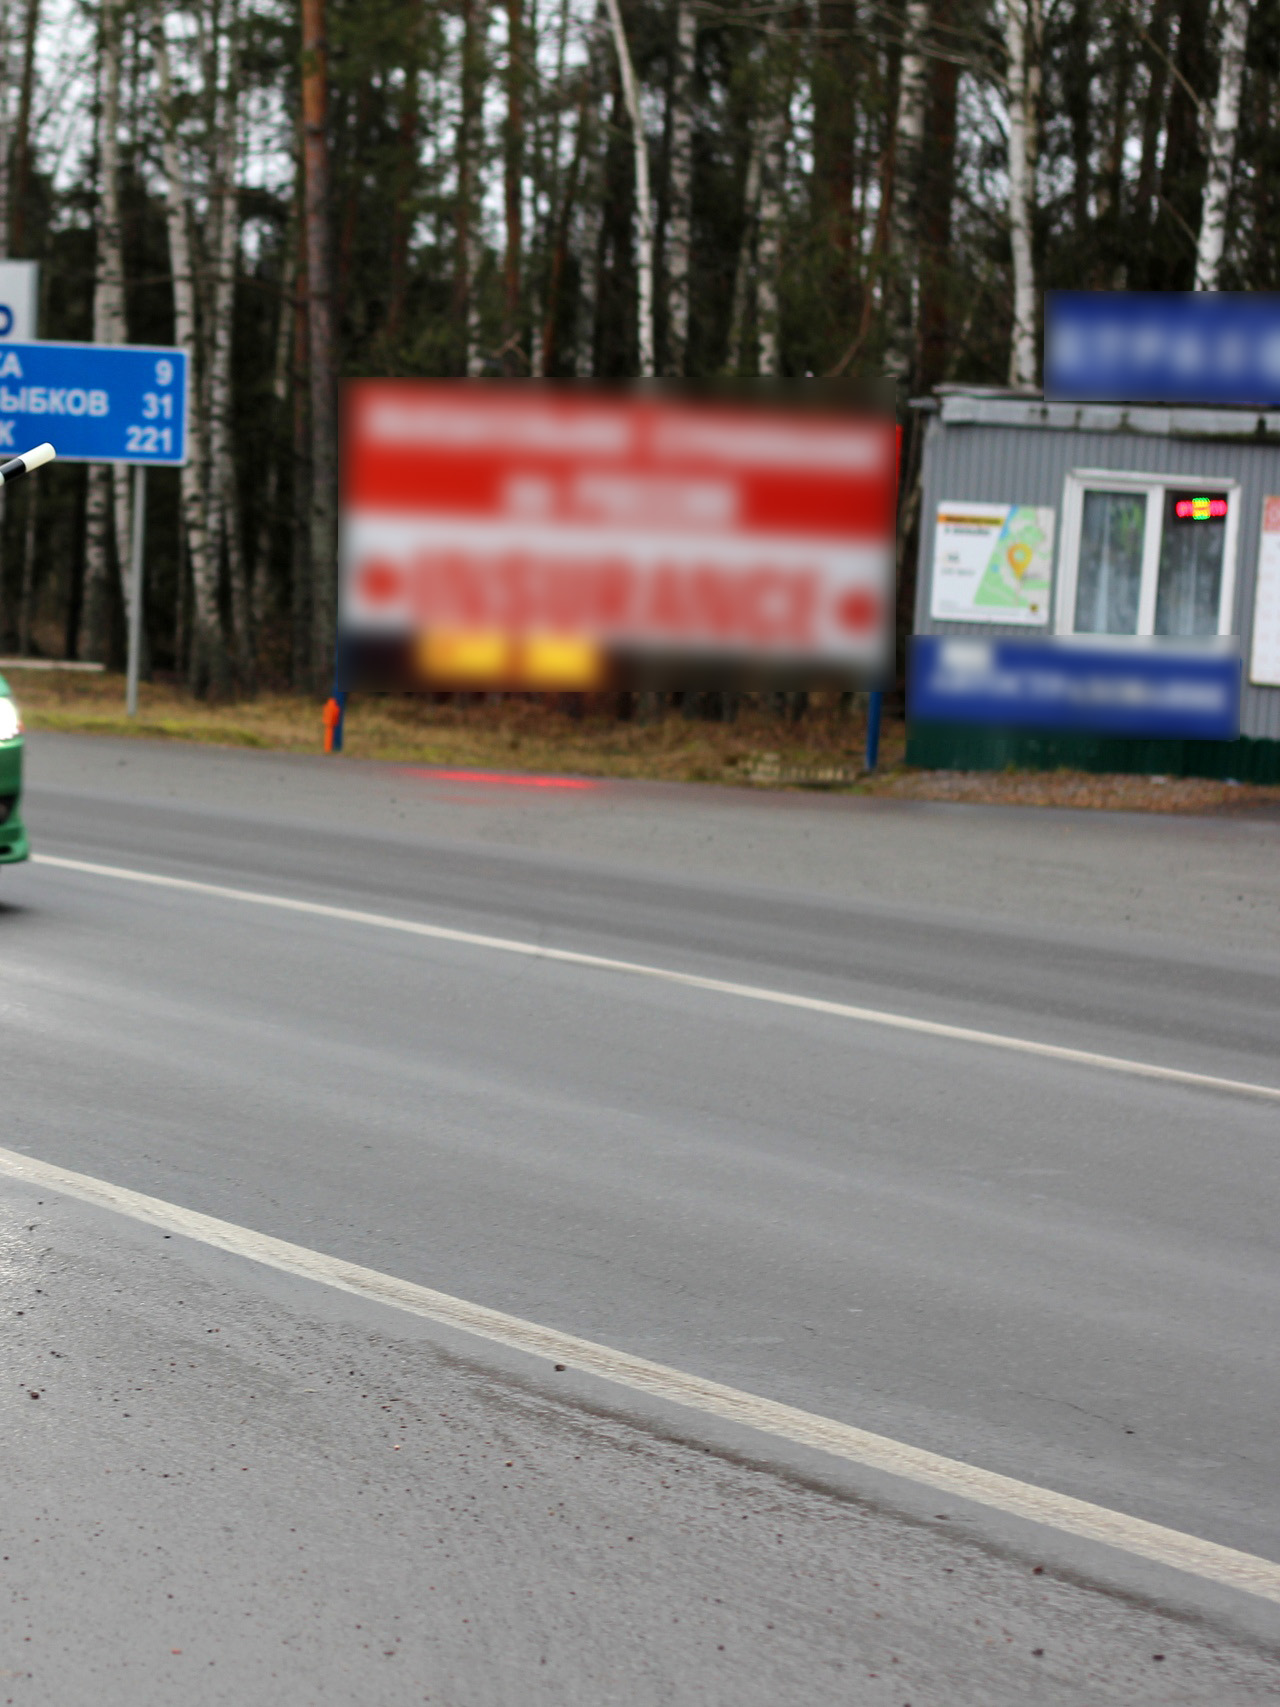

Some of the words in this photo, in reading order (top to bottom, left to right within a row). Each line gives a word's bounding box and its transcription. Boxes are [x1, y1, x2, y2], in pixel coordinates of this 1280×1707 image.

[155, 359, 174, 386] 9
[142, 392, 173, 420] 31
[125, 426, 173, 453] 221
